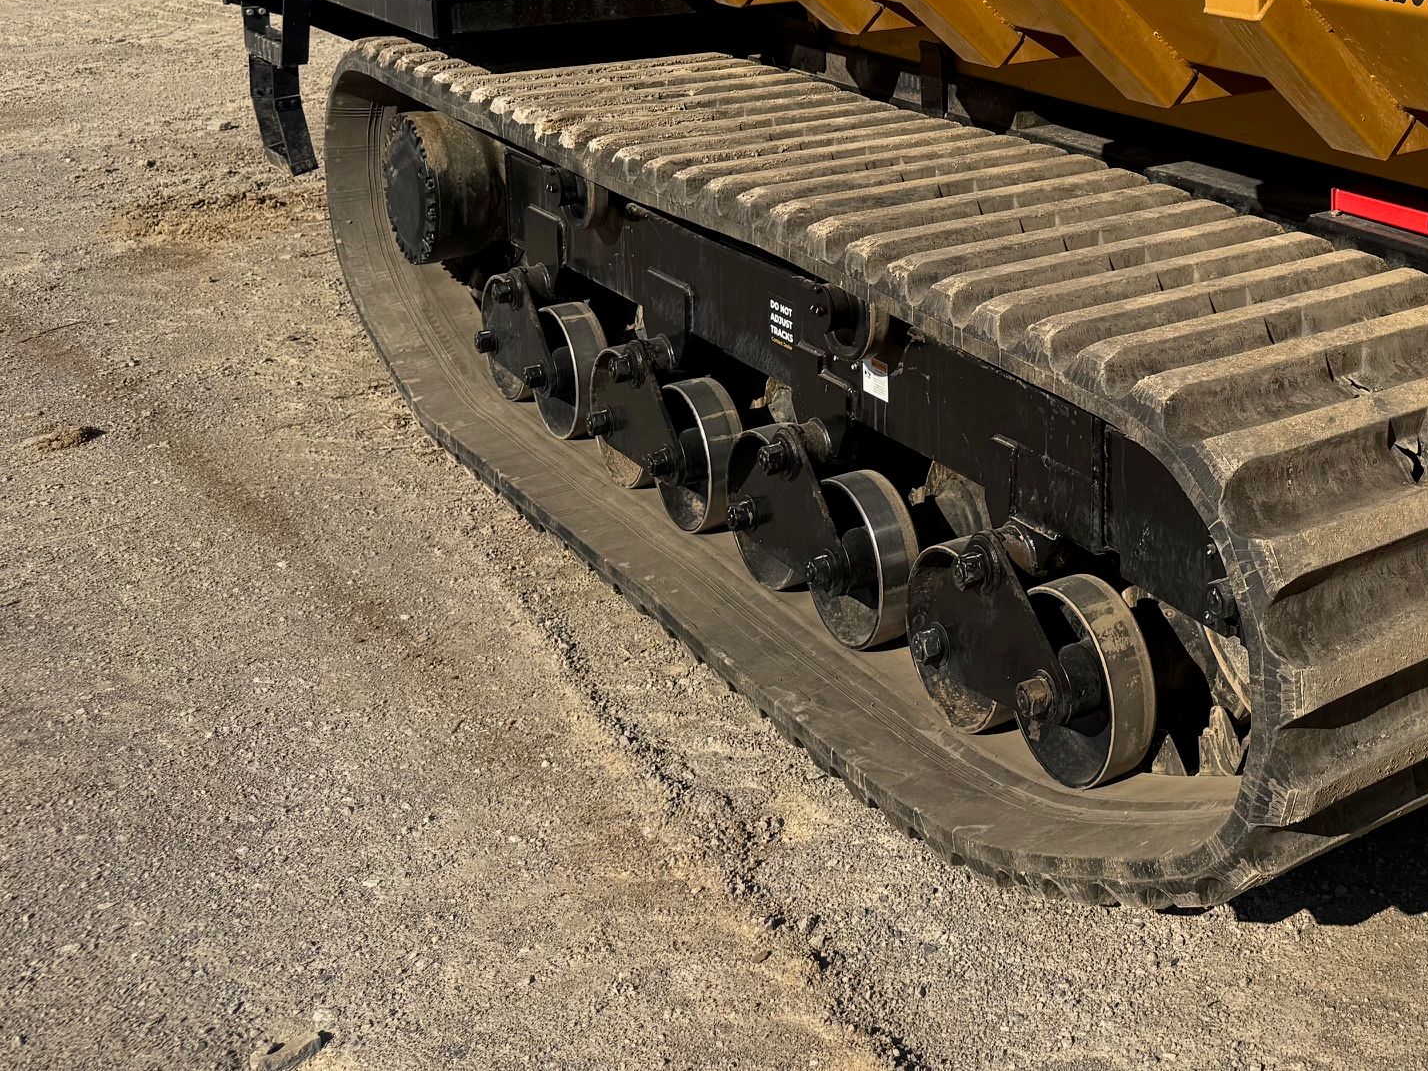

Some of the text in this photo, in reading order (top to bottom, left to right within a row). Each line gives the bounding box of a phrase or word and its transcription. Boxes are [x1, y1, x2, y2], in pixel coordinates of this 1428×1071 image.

[770, 299, 792, 318] DO NOT
[770, 312, 793, 330] ADJUST
[770, 324, 793, 343] TRACKS
